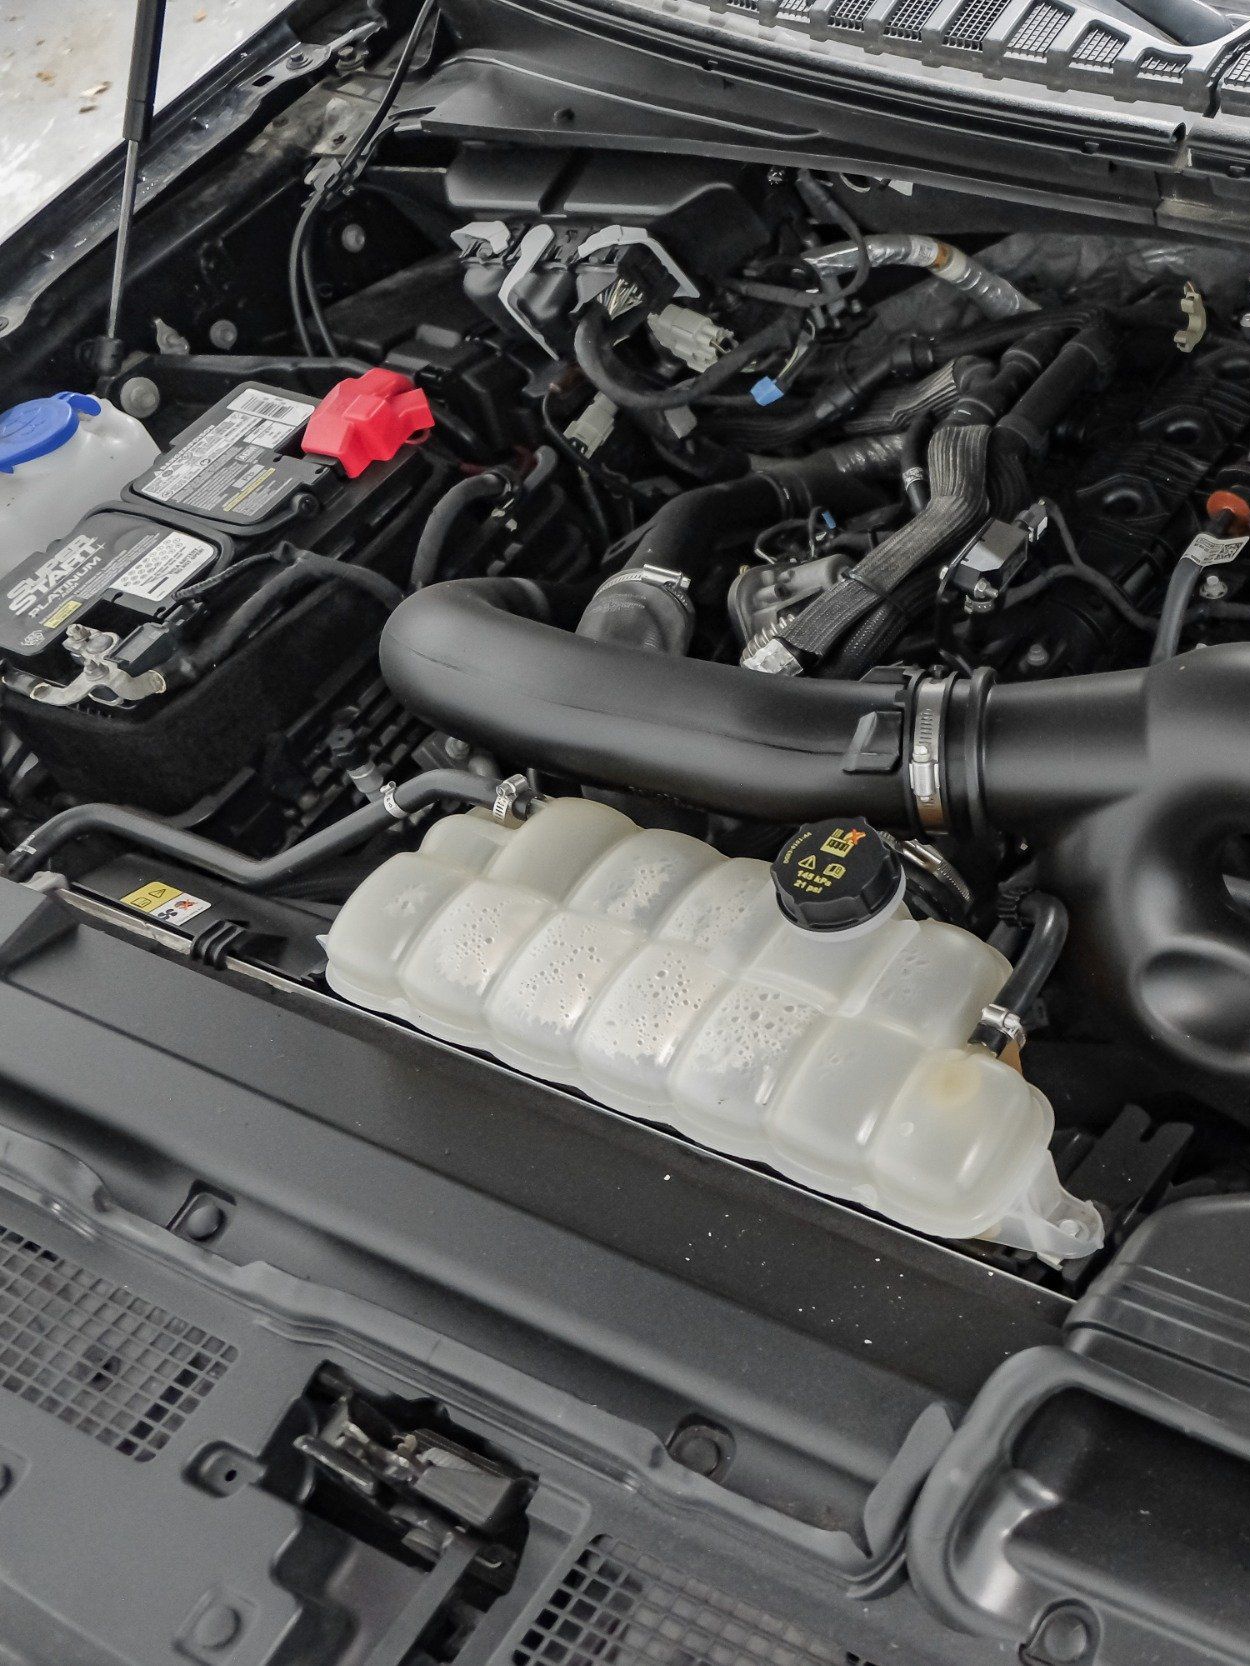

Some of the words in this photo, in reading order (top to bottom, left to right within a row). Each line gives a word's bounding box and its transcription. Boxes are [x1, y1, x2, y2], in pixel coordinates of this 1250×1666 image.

[7, 534, 93, 599] SUPER
[9, 537, 97, 616] START
[28, 556, 102, 618] PLATINUM
[793, 879, 807, 889] 21
[805, 884, 823, 894] psi
[797, 870, 815, 881] 145
